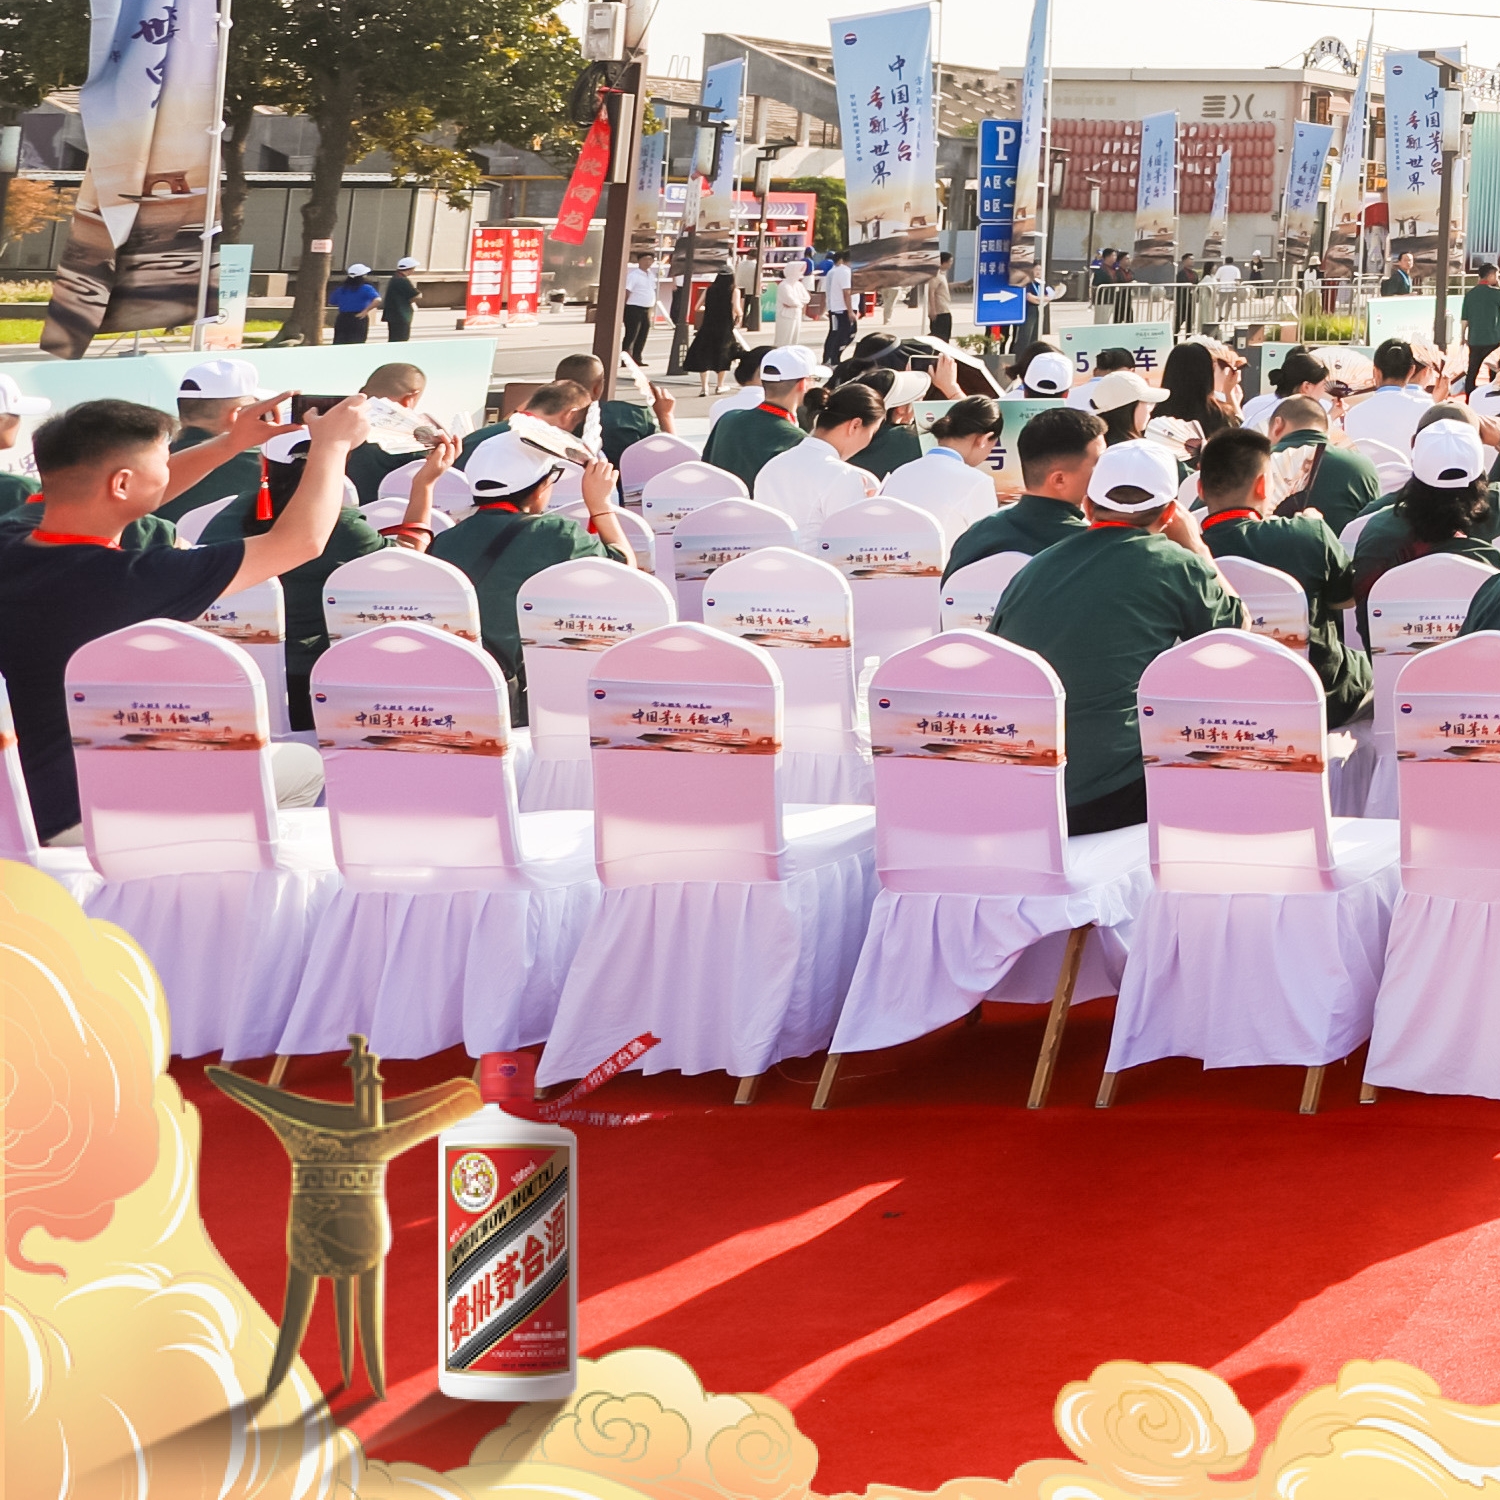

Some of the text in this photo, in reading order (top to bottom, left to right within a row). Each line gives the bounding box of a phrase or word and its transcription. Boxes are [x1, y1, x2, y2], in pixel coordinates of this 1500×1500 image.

[888, 54, 915, 162] 中国茅台
[866, 85, 891, 189] 香飘世界
[995, 126, 1016, 161] P
[1405, 109, 1426, 196] 香飘世界
[1075, 346, 1159, 373] 5车
[113, 710, 162, 725] 中国茅台
[355, 711, 404, 728] 中国茅台
[631, 708, 682, 725] 中国茅台
[916, 718, 967, 737] 中国茅台
[1180, 725, 1229, 742] 中国茅台
[1439, 721, 1489, 738] 中国茅台
